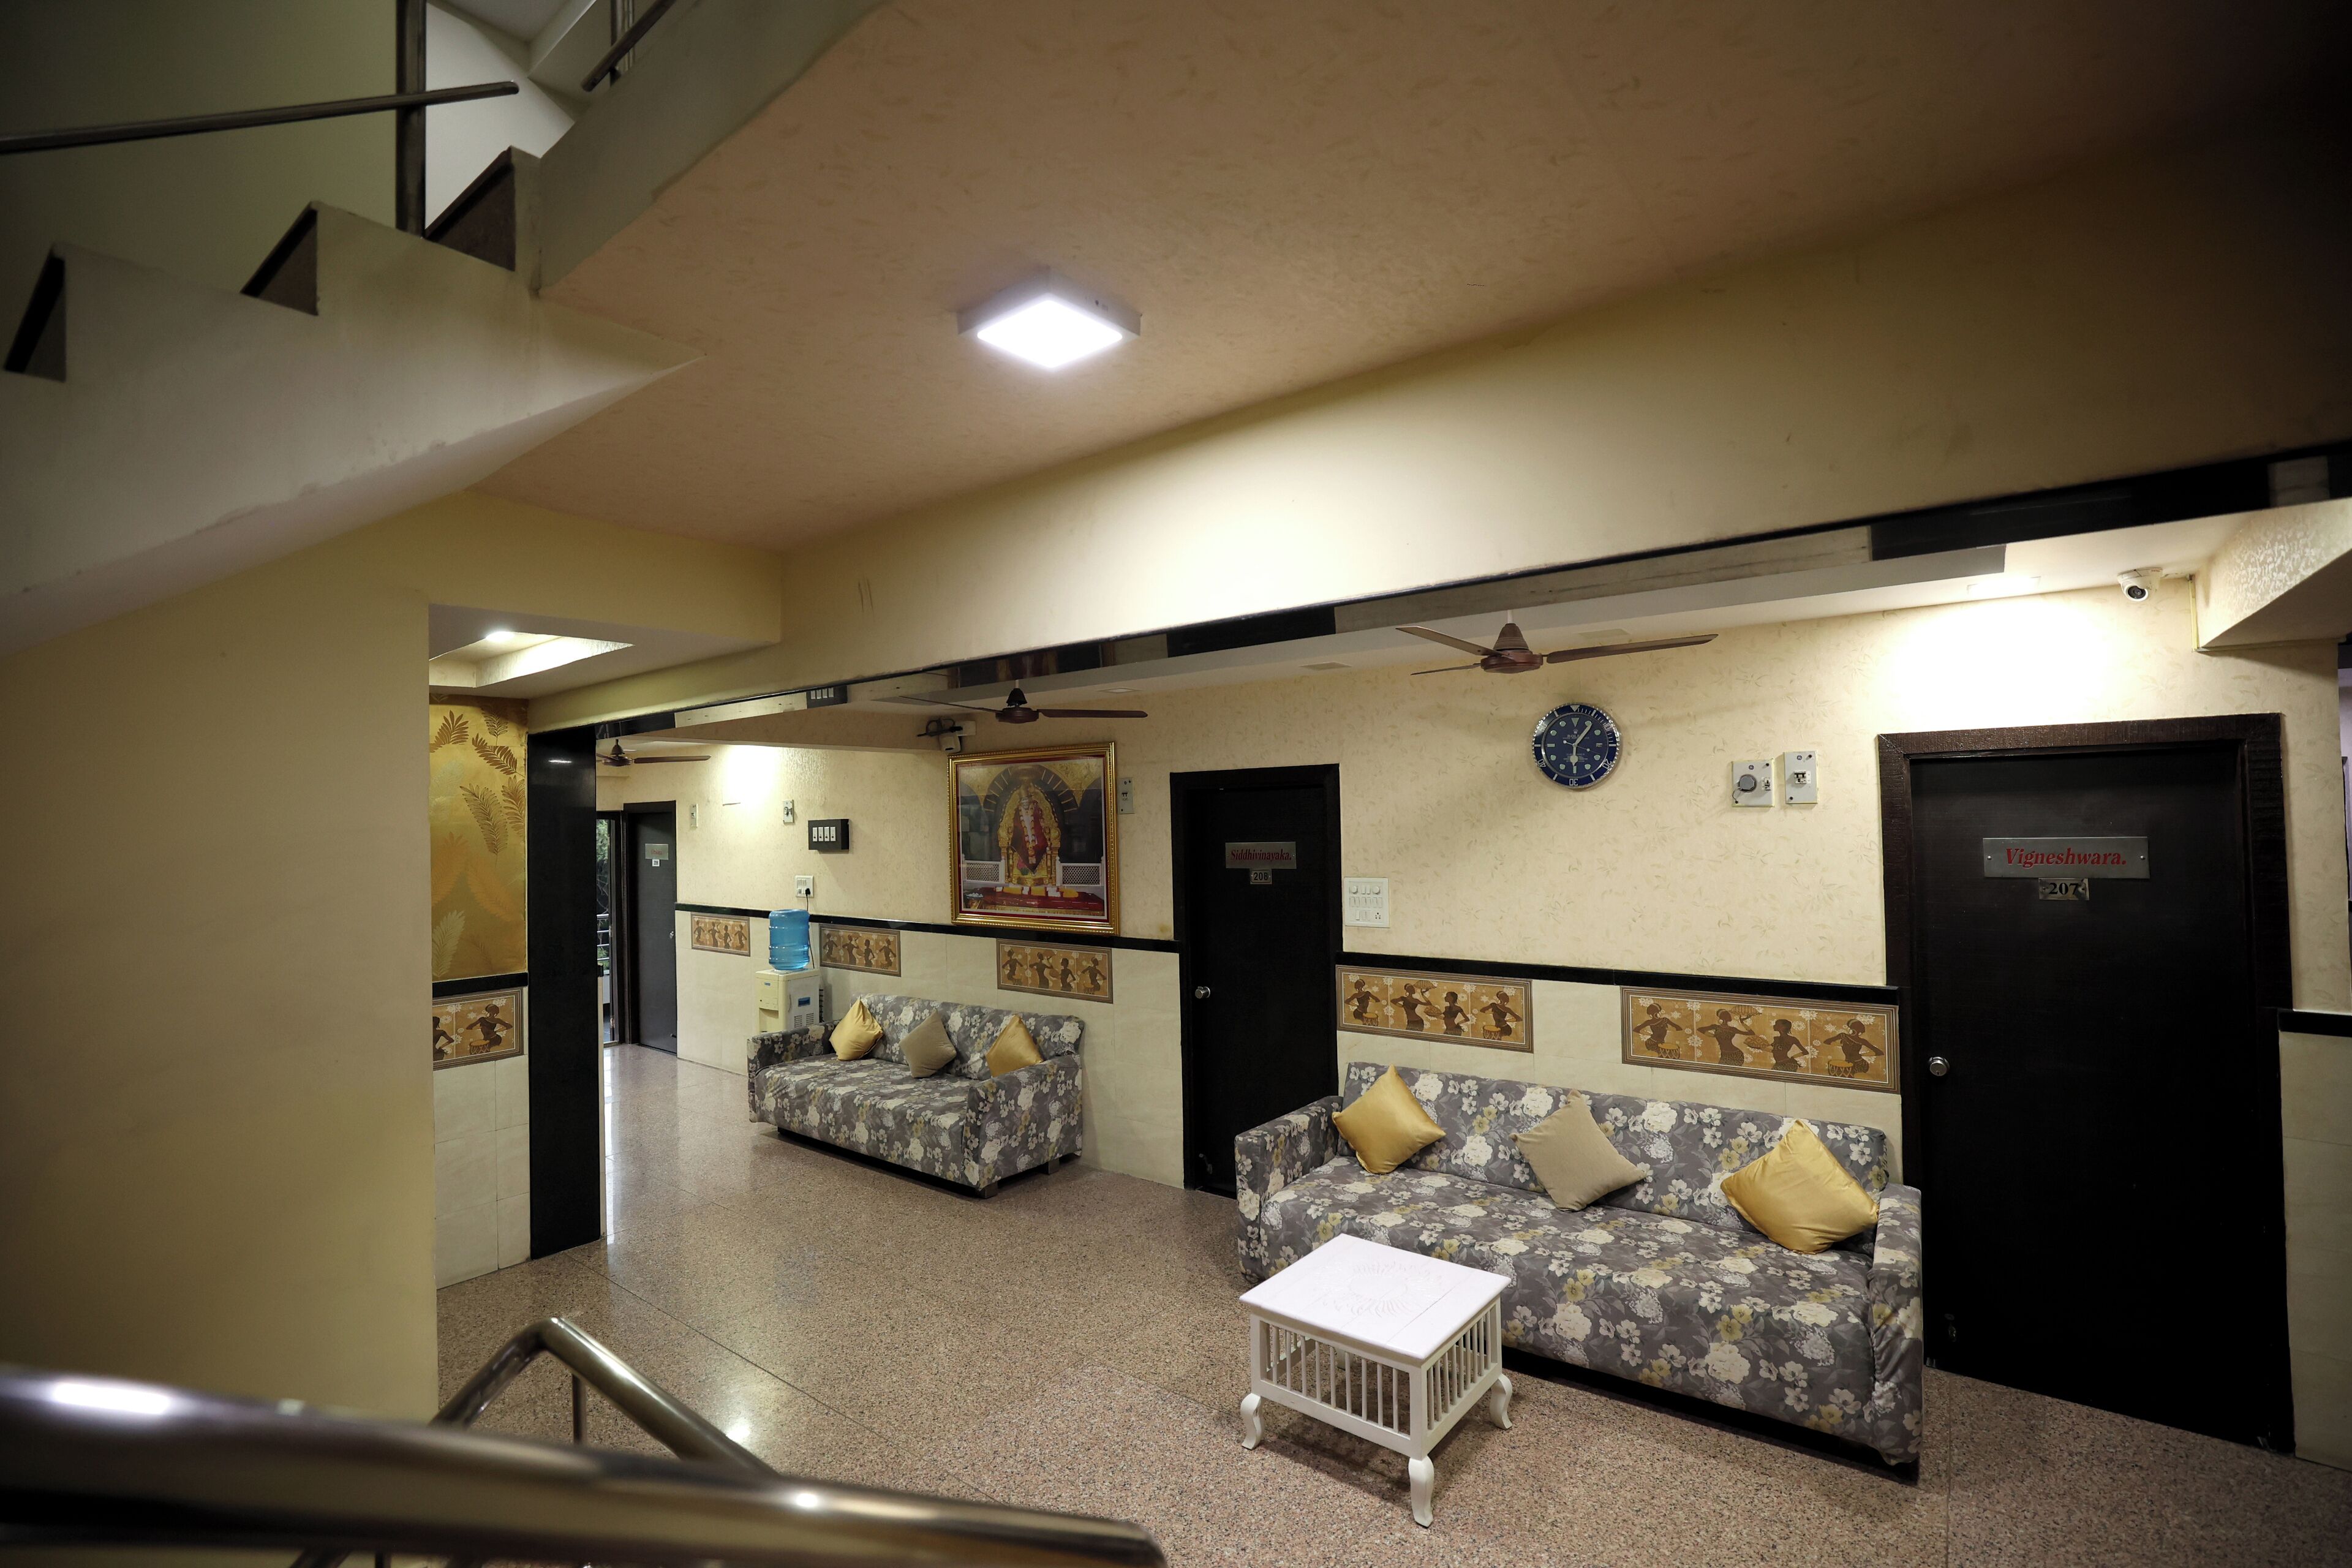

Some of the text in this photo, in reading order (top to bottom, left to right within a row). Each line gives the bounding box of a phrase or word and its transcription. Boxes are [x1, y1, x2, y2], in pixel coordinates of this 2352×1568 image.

[1537, 758, 1547, 767] 40
[1602, 758, 1612, 769] 20
[1230, 849, 1292, 862] Siddhivinayaka.
[2005, 848, 2127, 868] Vigneshwara.
[1253, 872, 1268, 881] 208
[2048, 882, 2080, 895] 207
